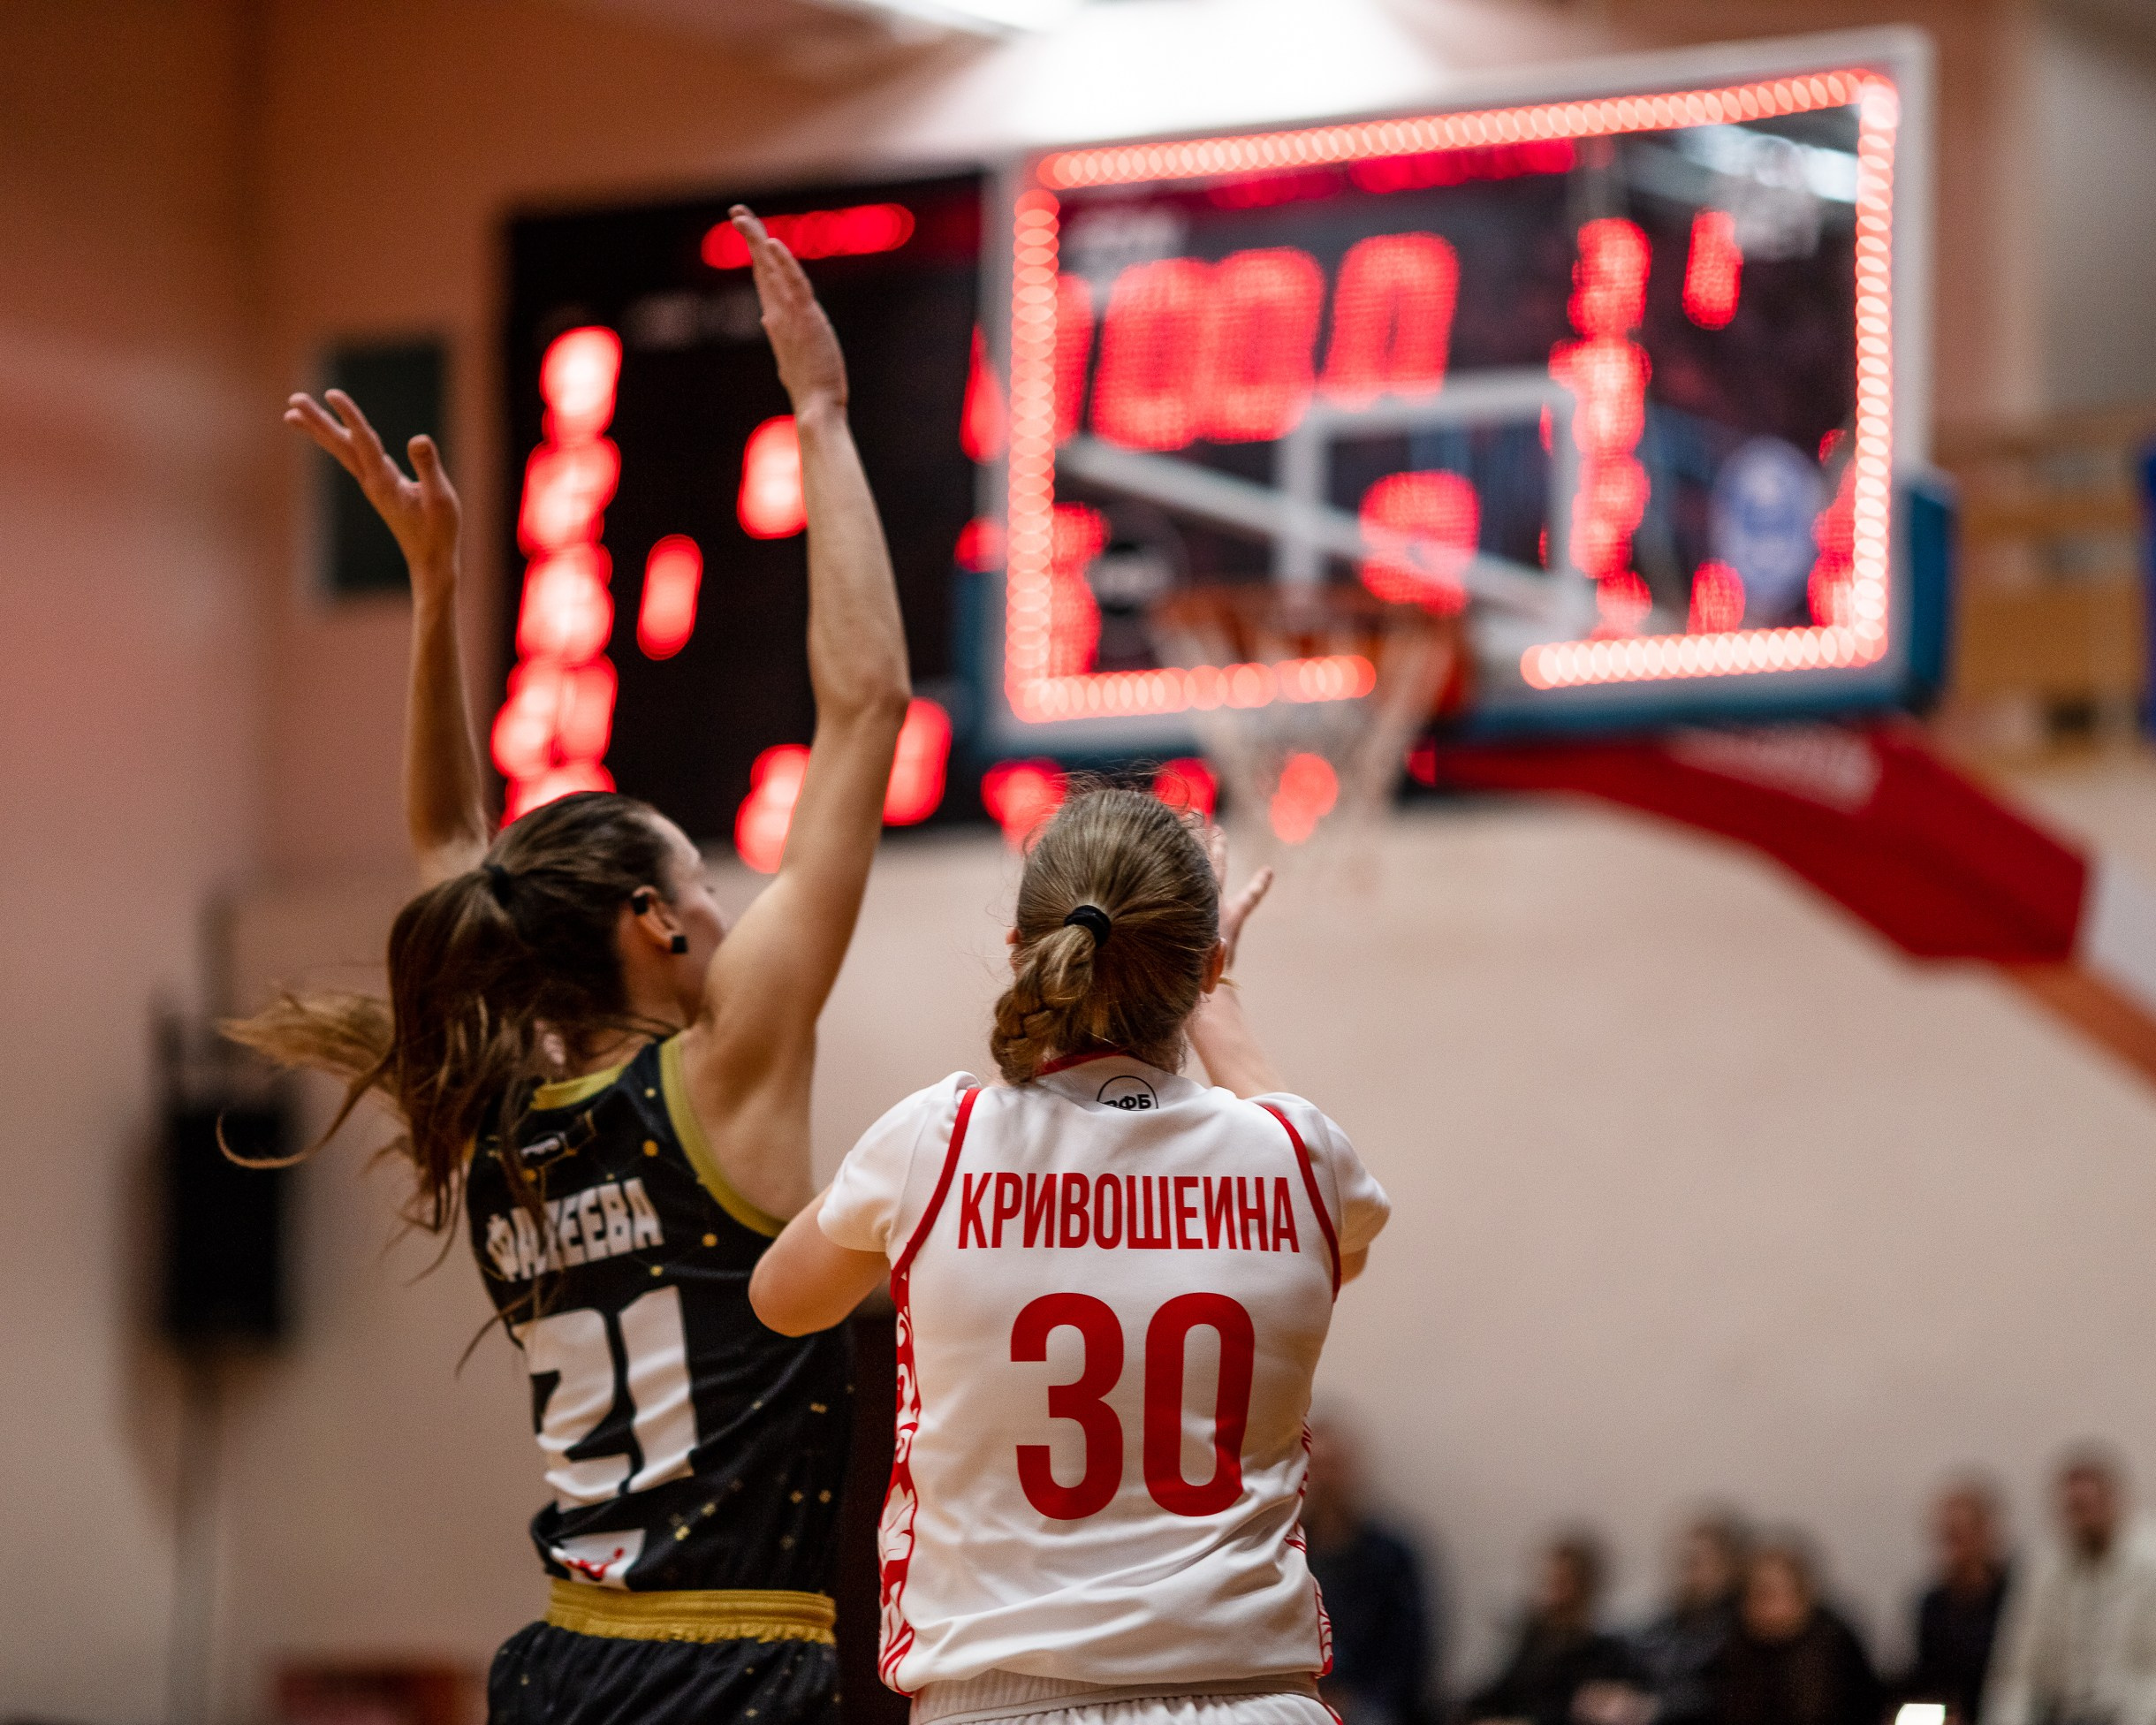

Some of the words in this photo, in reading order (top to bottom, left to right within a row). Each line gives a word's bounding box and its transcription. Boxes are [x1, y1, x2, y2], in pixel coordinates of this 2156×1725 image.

[958, 1172, 1300, 1253] КРИВОШЕИНА
[513, 1285, 699, 1512] 21
[1010, 1292, 1255, 1520] 30
